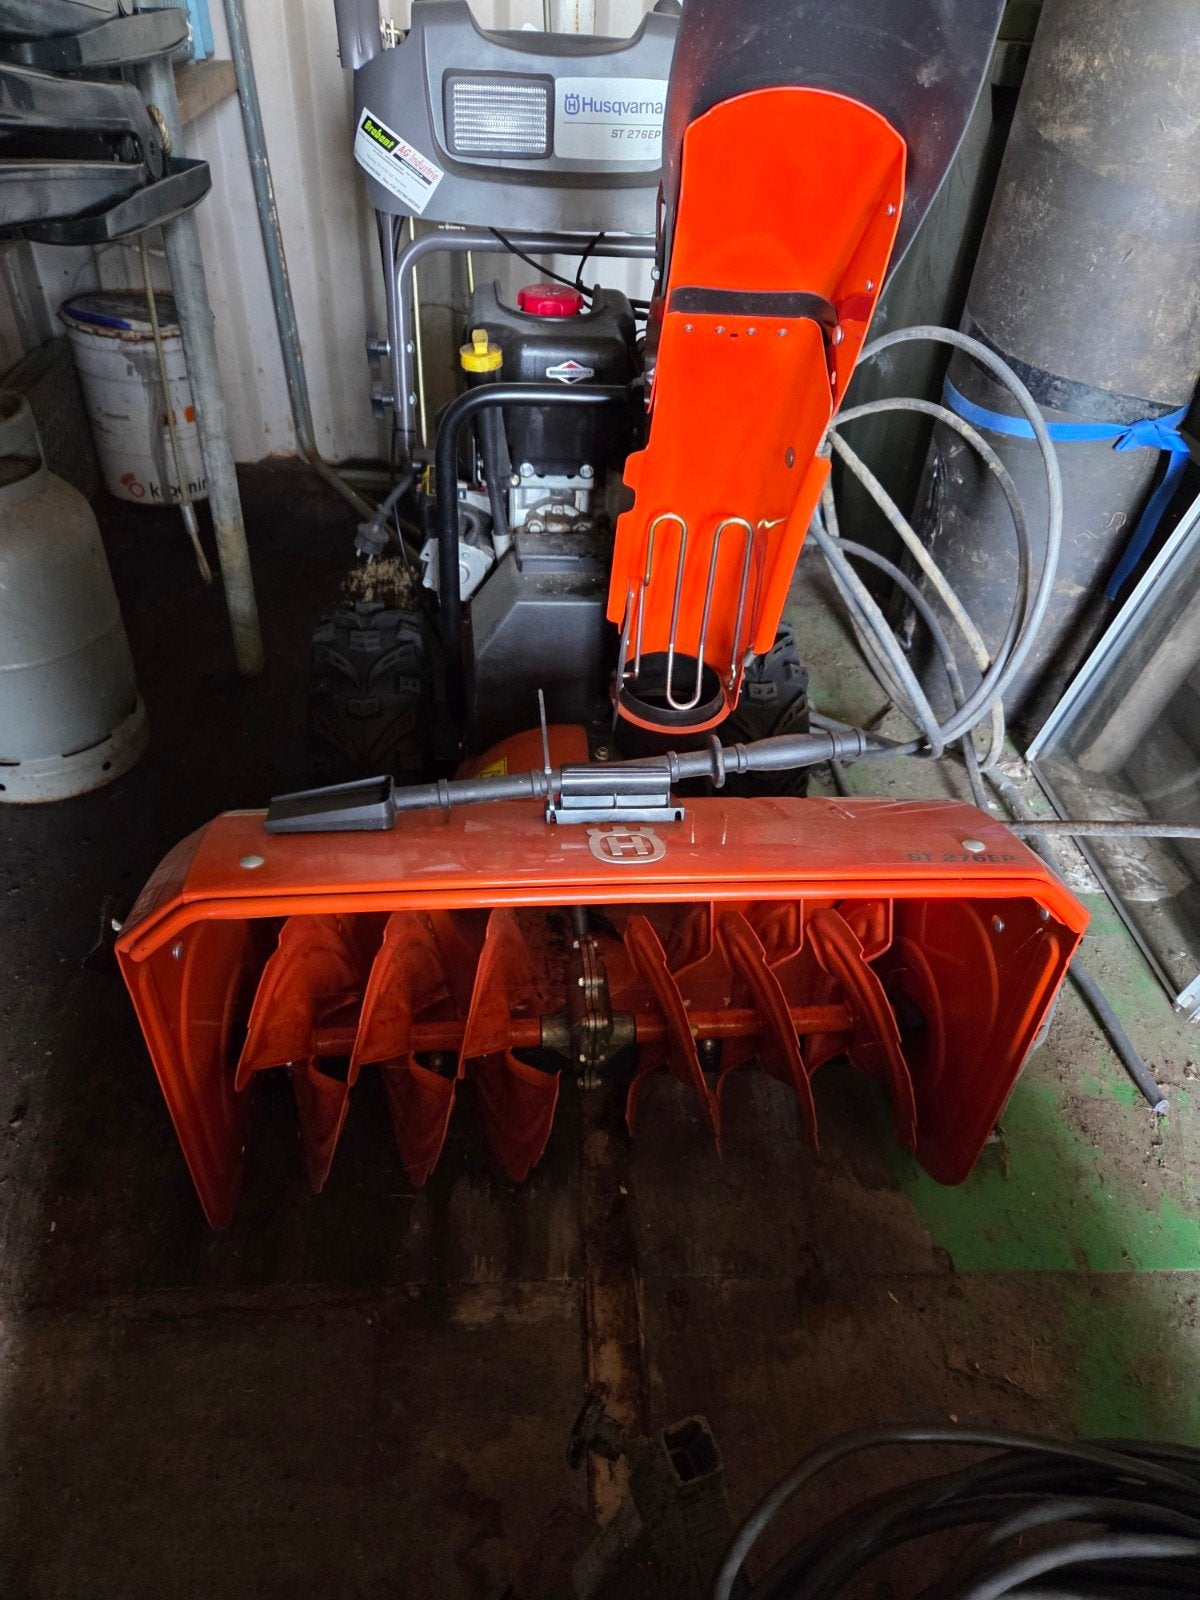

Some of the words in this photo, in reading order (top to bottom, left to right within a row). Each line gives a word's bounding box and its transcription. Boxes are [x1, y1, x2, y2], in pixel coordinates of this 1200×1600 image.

[582, 97, 663, 116] Husqvarna
[364, 119, 395, 149] Brabant
[611, 129, 625, 139] ST
[627, 129, 662, 139] 276EP
[397, 145, 412, 158] AG
[410, 153, 439, 181] Industrie
[907, 853, 932, 862] ST
[942, 853, 1015, 862] 276EP
